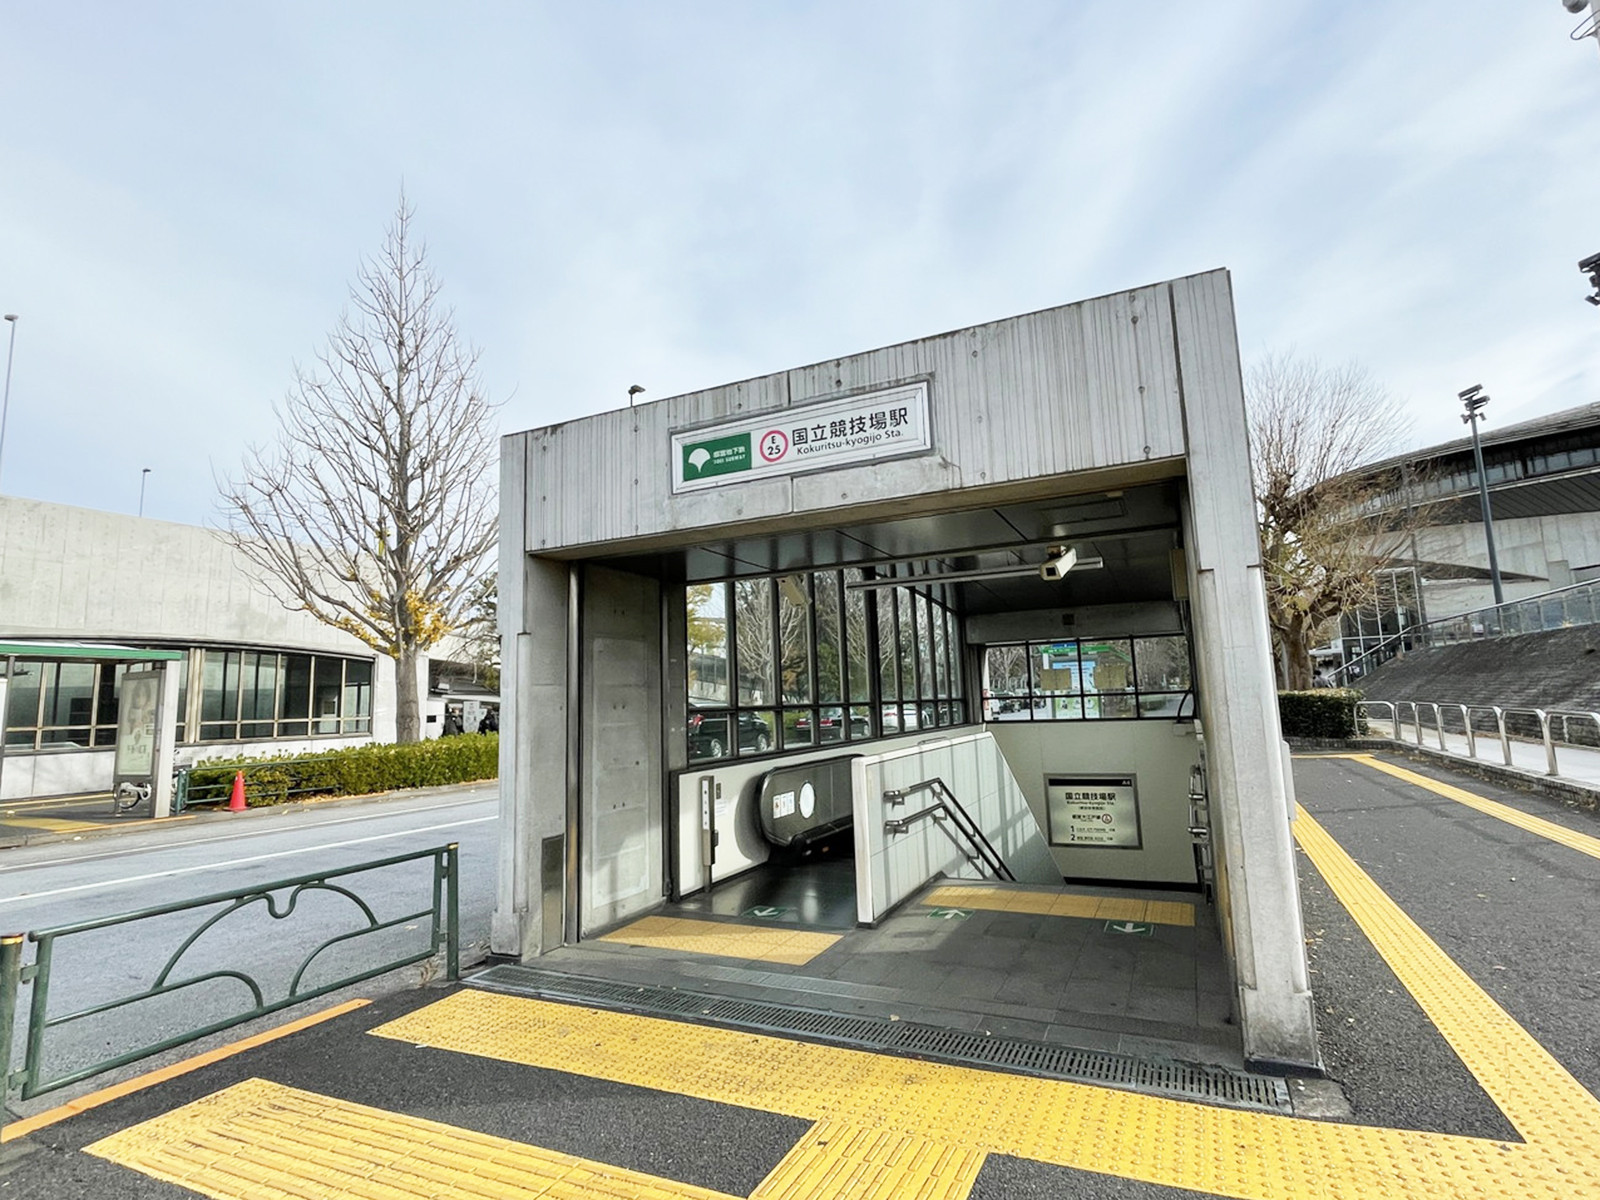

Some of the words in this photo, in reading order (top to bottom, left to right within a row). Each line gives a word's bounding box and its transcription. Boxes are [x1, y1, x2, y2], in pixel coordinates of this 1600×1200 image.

[792, 407, 907, 446] 国立競技場駅
[771, 435, 777, 444] E
[797, 432, 882, 455] Kokuritsu-kyogijo
[885, 430, 904, 439] Sta.
[767, 445, 781, 455] 25
